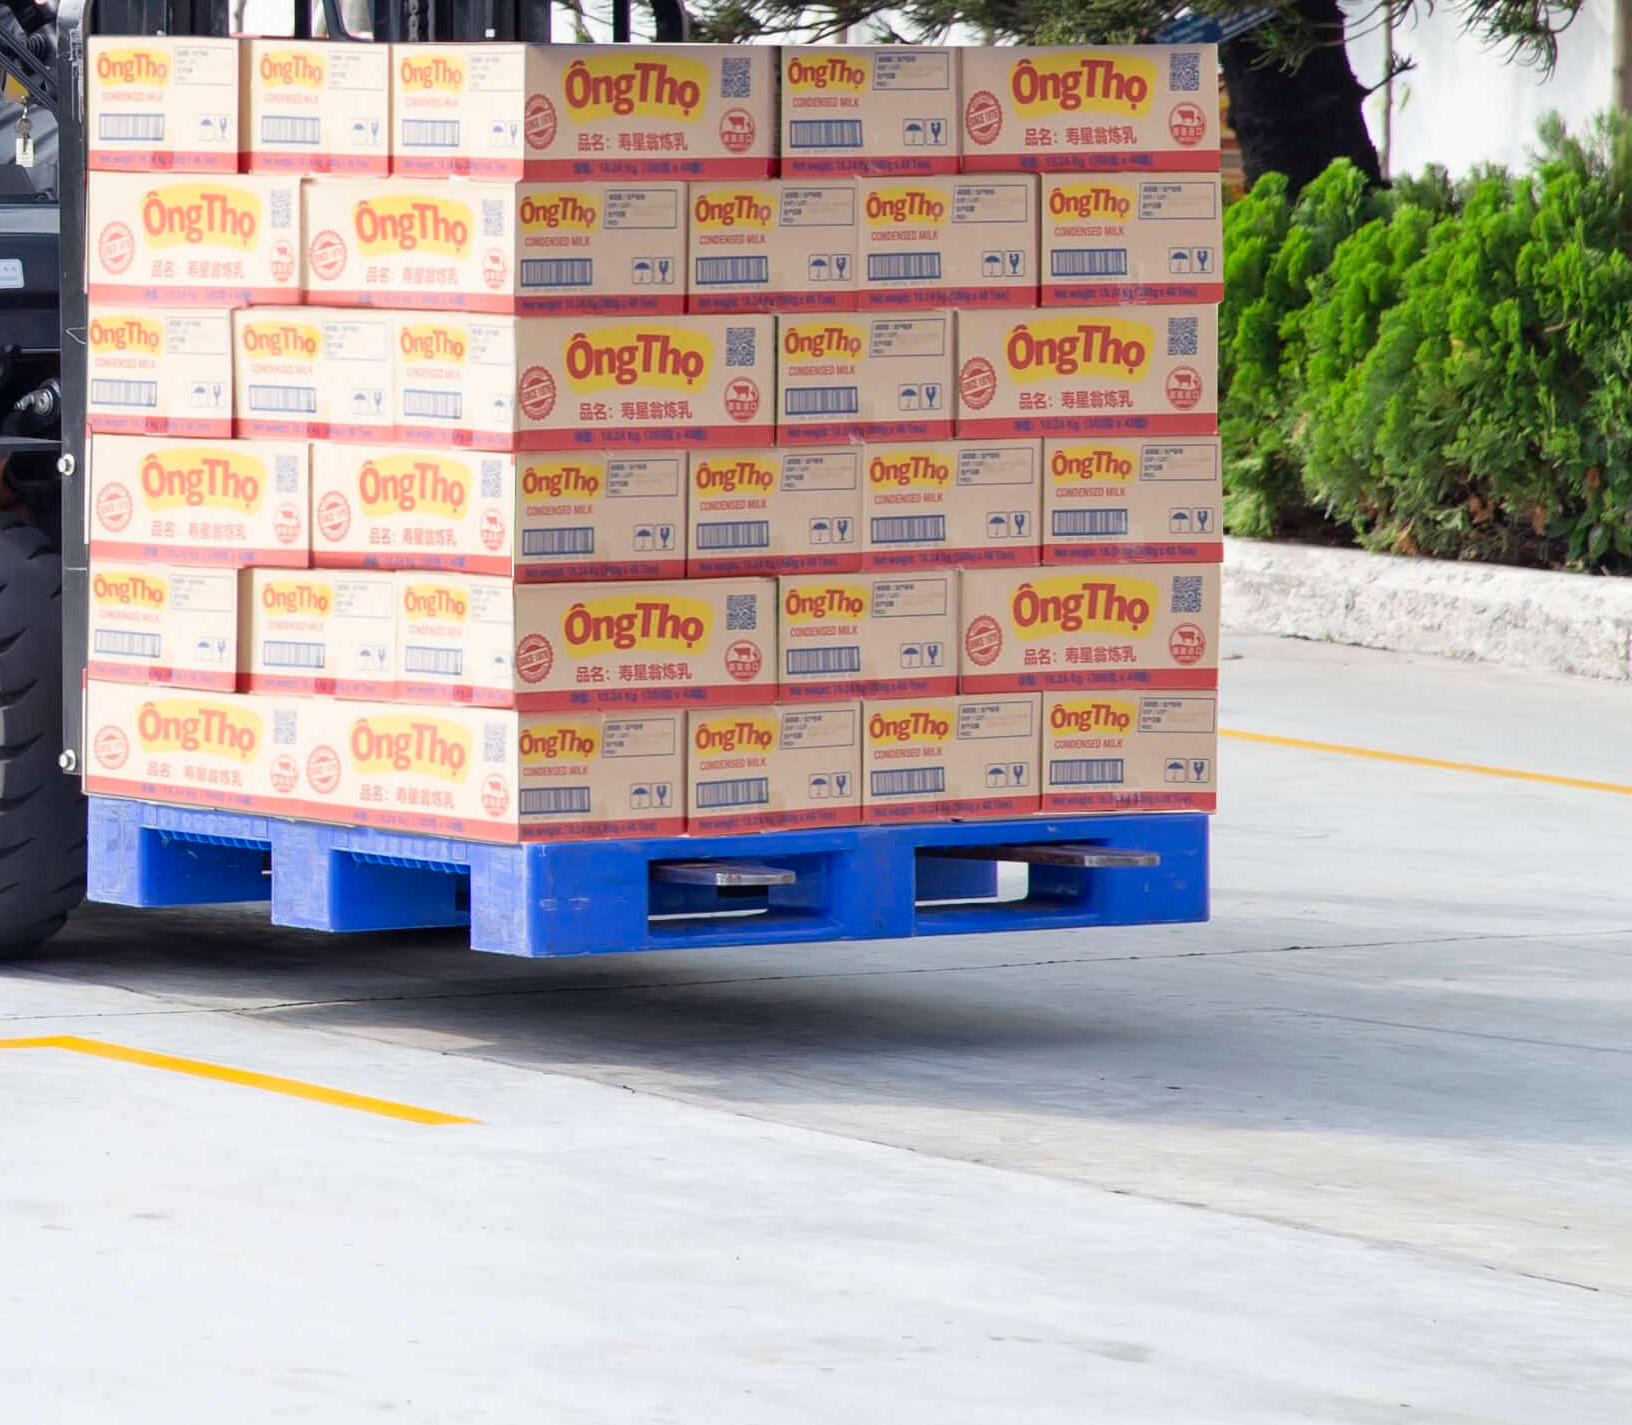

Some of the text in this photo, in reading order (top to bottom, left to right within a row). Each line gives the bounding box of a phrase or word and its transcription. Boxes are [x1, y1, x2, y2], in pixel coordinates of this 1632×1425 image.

[792, 96, 860, 108] CONDENSED MILK
[871, 230, 938, 242] CONDENSED MILK
[1055, 226, 1126, 237] CONDENSED MILK
[523, 236, 591, 248] CONDENSED MILK
[700, 232, 767, 245] CONDENSED MILK
[789, 365, 855, 376] CONDENSED MILK
[1056, 486, 1127, 498] CONDENSED MILK
[875, 493, 943, 504] CONDENSED MILK
[527, 505, 594, 516] CONDENSED MILK
[700, 499, 767, 511] CONDENSED MILK
[790, 624, 857, 637] CONDENSED MILK
[1054, 739, 1123, 749] CONDENSED MILK
[873, 747, 942, 759] CONDENSED MILK
[700, 757, 767, 770] CONDENSED MILK
[523, 764, 588, 776] CONDENSED MILK
